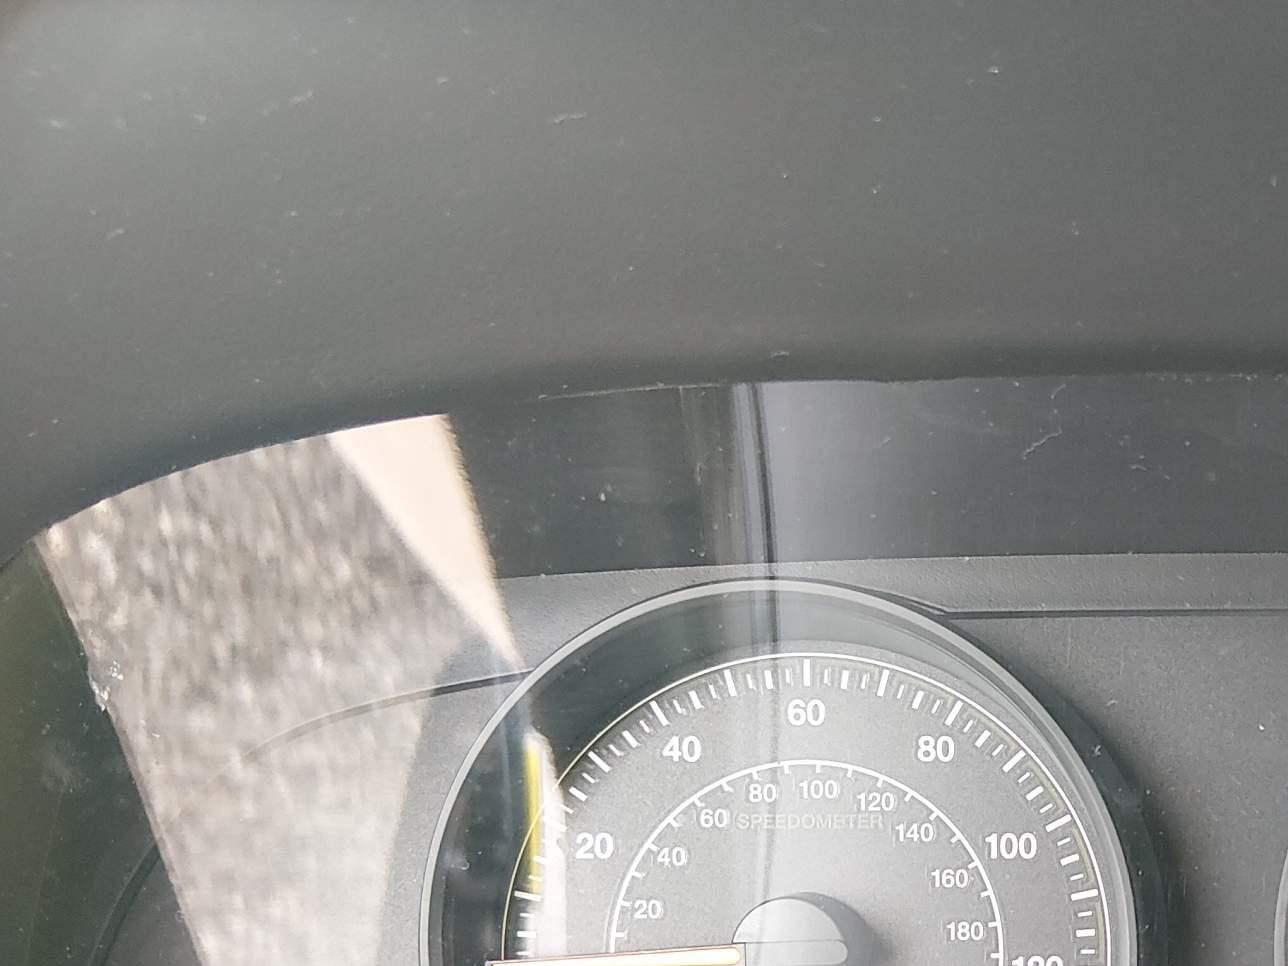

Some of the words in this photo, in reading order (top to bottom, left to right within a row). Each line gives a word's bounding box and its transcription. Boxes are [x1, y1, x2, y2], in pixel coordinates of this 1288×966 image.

[787, 699, 826, 726] 60
[662, 735, 702, 763] 40
[917, 735, 955, 763] 80
[748, 782, 778, 803] 80
[798, 779, 838, 799] 100
[856, 791, 895, 812] 120
[699, 808, 729, 828] 60
[736, 810, 883, 829] SPEEDOMETER
[895, 822, 935, 843] 140
[575, 832, 614, 860] 20
[657, 846, 687, 867] 40
[985, 832, 1037, 860] 100
[930, 868, 969, 889] 160
[633, 899, 662, 919] 20
[946, 921, 984, 942] 180
